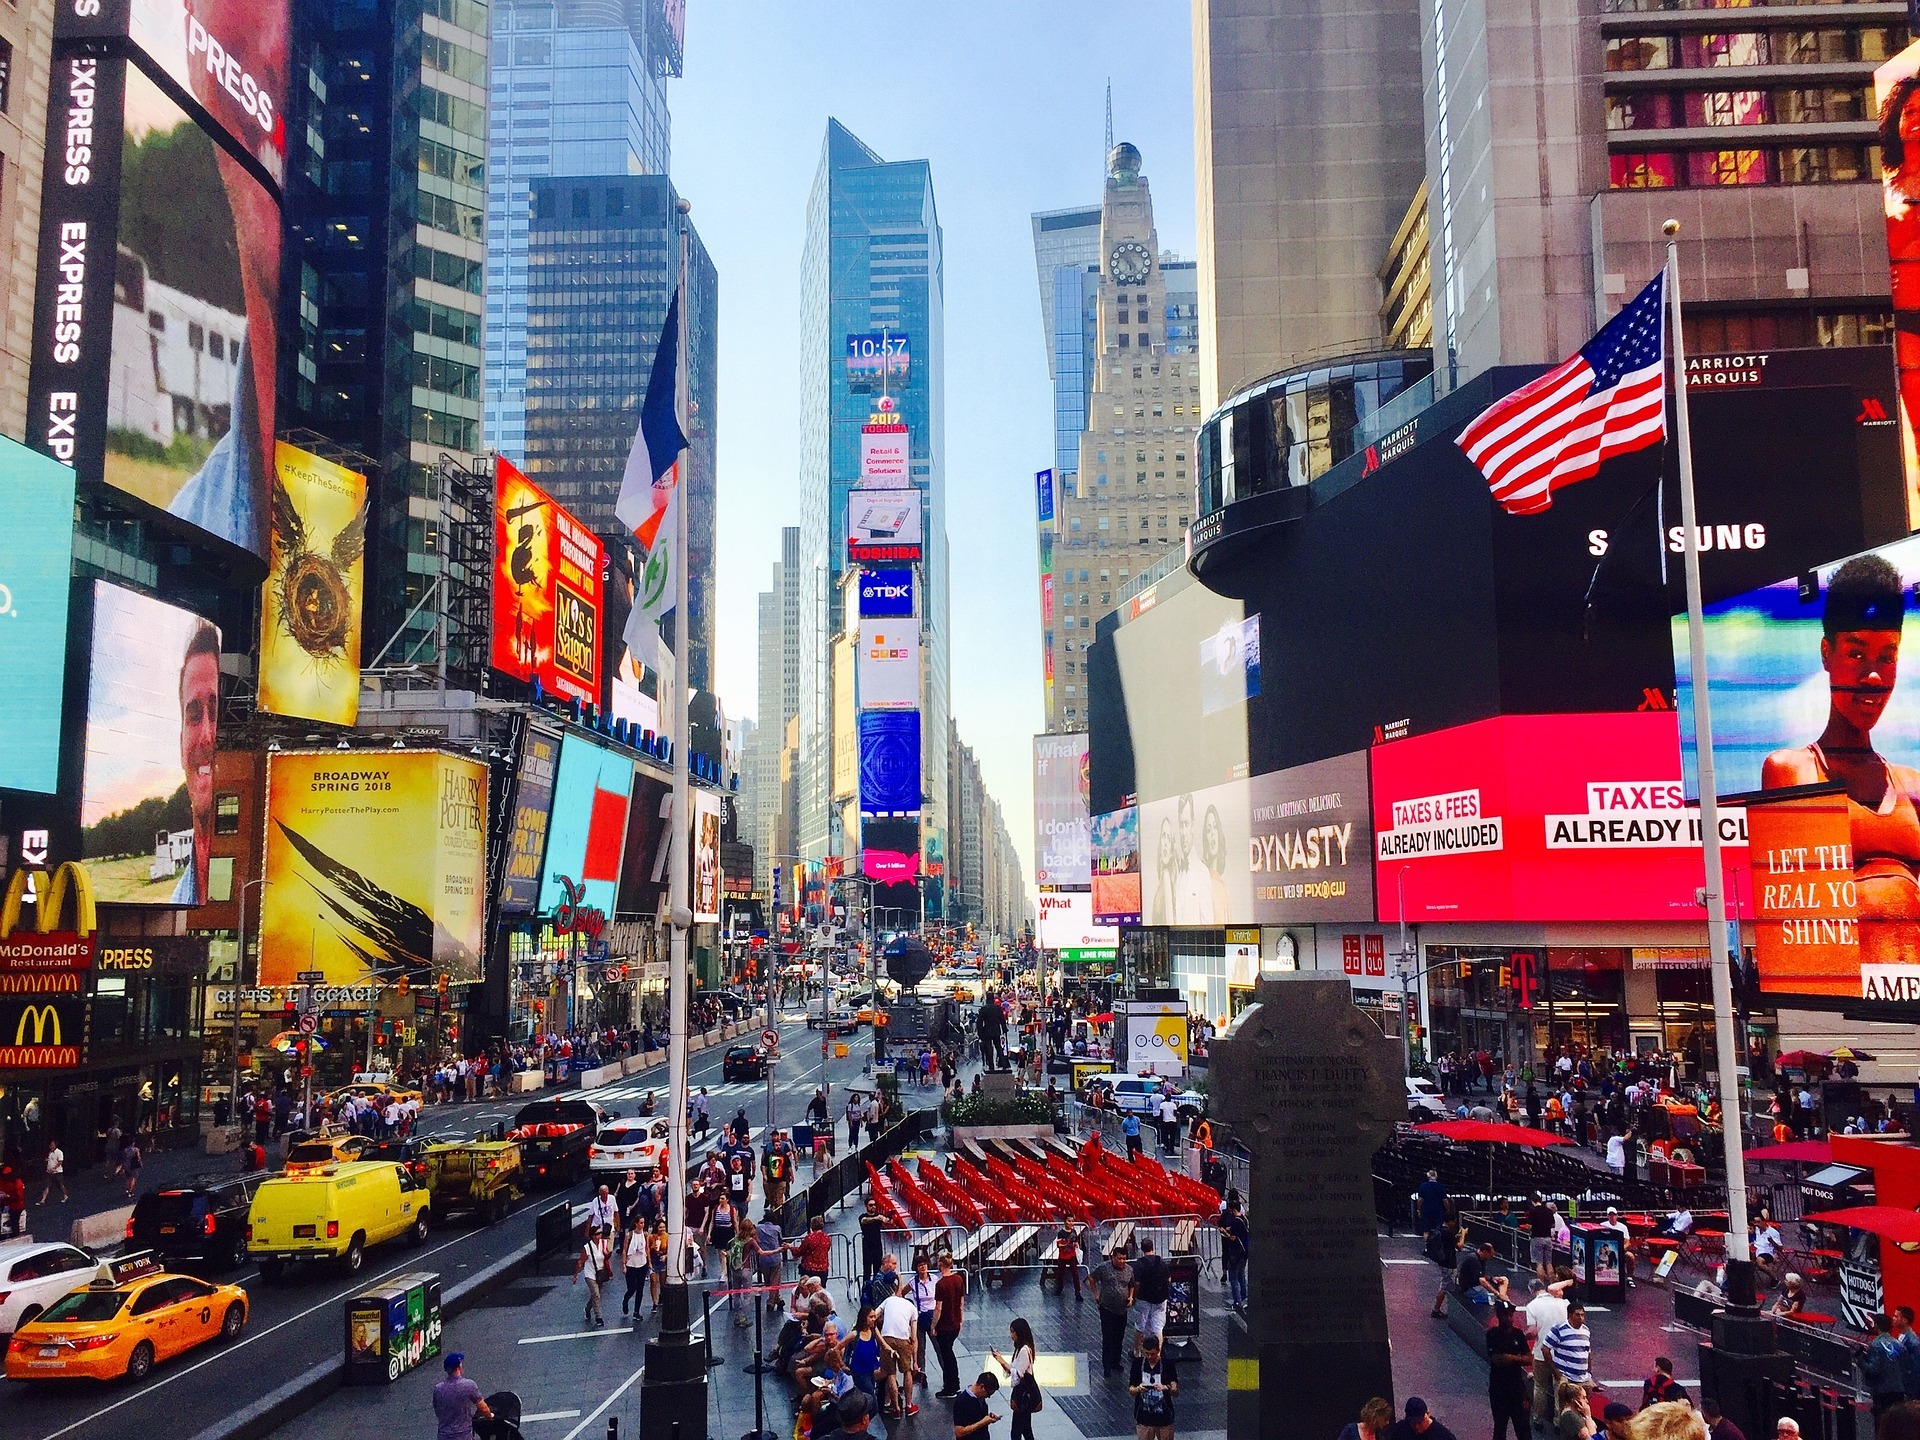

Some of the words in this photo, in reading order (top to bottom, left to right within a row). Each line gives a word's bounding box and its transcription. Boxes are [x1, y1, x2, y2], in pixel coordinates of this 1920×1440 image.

[54, 222, 87, 364] EXPRESS
[850, 340, 907, 358] 10:57
[1684, 355, 1769, 370] ARRIOTT
[870, 414, 900, 425] 2017
[48, 392, 77, 467] EXP
[862, 425, 908, 433] TOSHIBA
[1381, 419, 1419, 449] MARRIOTT
[1381, 436, 1415, 462] MARQUIS
[285, 463, 357, 500] #KeepTheSecrets
[1192, 509, 1226, 534] MARRIOTT
[1192, 524, 1222, 546] MARQUIS
[850, 547, 920, 560] TOSHIBA
[873, 586, 908, 598] TDK
[557, 625, 592, 674] Saigon
[410, 727, 441, 735] LAMAR
[1384, 718, 1410, 732] MARRIOTT
[1384, 728, 1408, 740] MARQUIS
[1036, 741, 1079, 758] What
[1038, 760, 1048, 775] if
[313, 771, 390, 781] BROADWAY
[311, 782, 360, 792] SPRING
[364, 782, 392, 791] 2018
[444, 768, 482, 806] HARRY
[1309, 792, 1343, 813] DELICIOUS.
[1593, 786, 1684, 810] TAXES
[301, 806, 400, 816] HarryPotterThePlay.com
[440, 797, 483, 832] POTTER
[1395, 799, 1432, 826] TAXES
[1434, 801, 1443, 821] &
[1446, 794, 1477, 820] FEES
[517, 807, 547, 834] COME
[1046, 818, 1087, 835] don't
[1553, 820, 1681, 844] ALREADY
[1689, 818, 1749, 841] ICL
[1052, 836, 1087, 851] hold
[1248, 822, 1352, 873] DYNASTY
[1380, 830, 1431, 856] ALREADY
[1434, 823, 1498, 852] INCLUDED
[509, 854, 541, 879] AWAY
[1043, 852, 1087, 867] back.
[1768, 848, 1808, 875] LET
[1814, 845, 1853, 872] TH
[445, 874, 474, 885] BROADWAY
[444, 886, 463, 895] SPRING
[463, 887, 474, 896] 2018
[1283, 885, 1296, 899] WED
[1763, 883, 1821, 910] REAL
[1039, 897, 1071, 909] What
[1040, 910, 1048, 921] if
[0, 943, 89, 957] McDonald's
[1080, 951, 1097, 959] LINE
[1366, 940, 1381, 954] UNI
[10, 958, 72, 967] Restaurant
[1367, 957, 1383, 972] QLO
[1866, 976, 1920, 1001] AME
[1255, 1068, 1308, 1081] FRANCIS
[1325, 1068, 1369, 1081] DUFFY
[1801, 1185, 1814, 1196] HOT
[1815, 1187, 1834, 1200] DOGS
[119, 1262, 133, 1274] NEW
[134, 1257, 152, 1269] YORK
[1848, 1273, 1876, 1293] HOTDOGS
